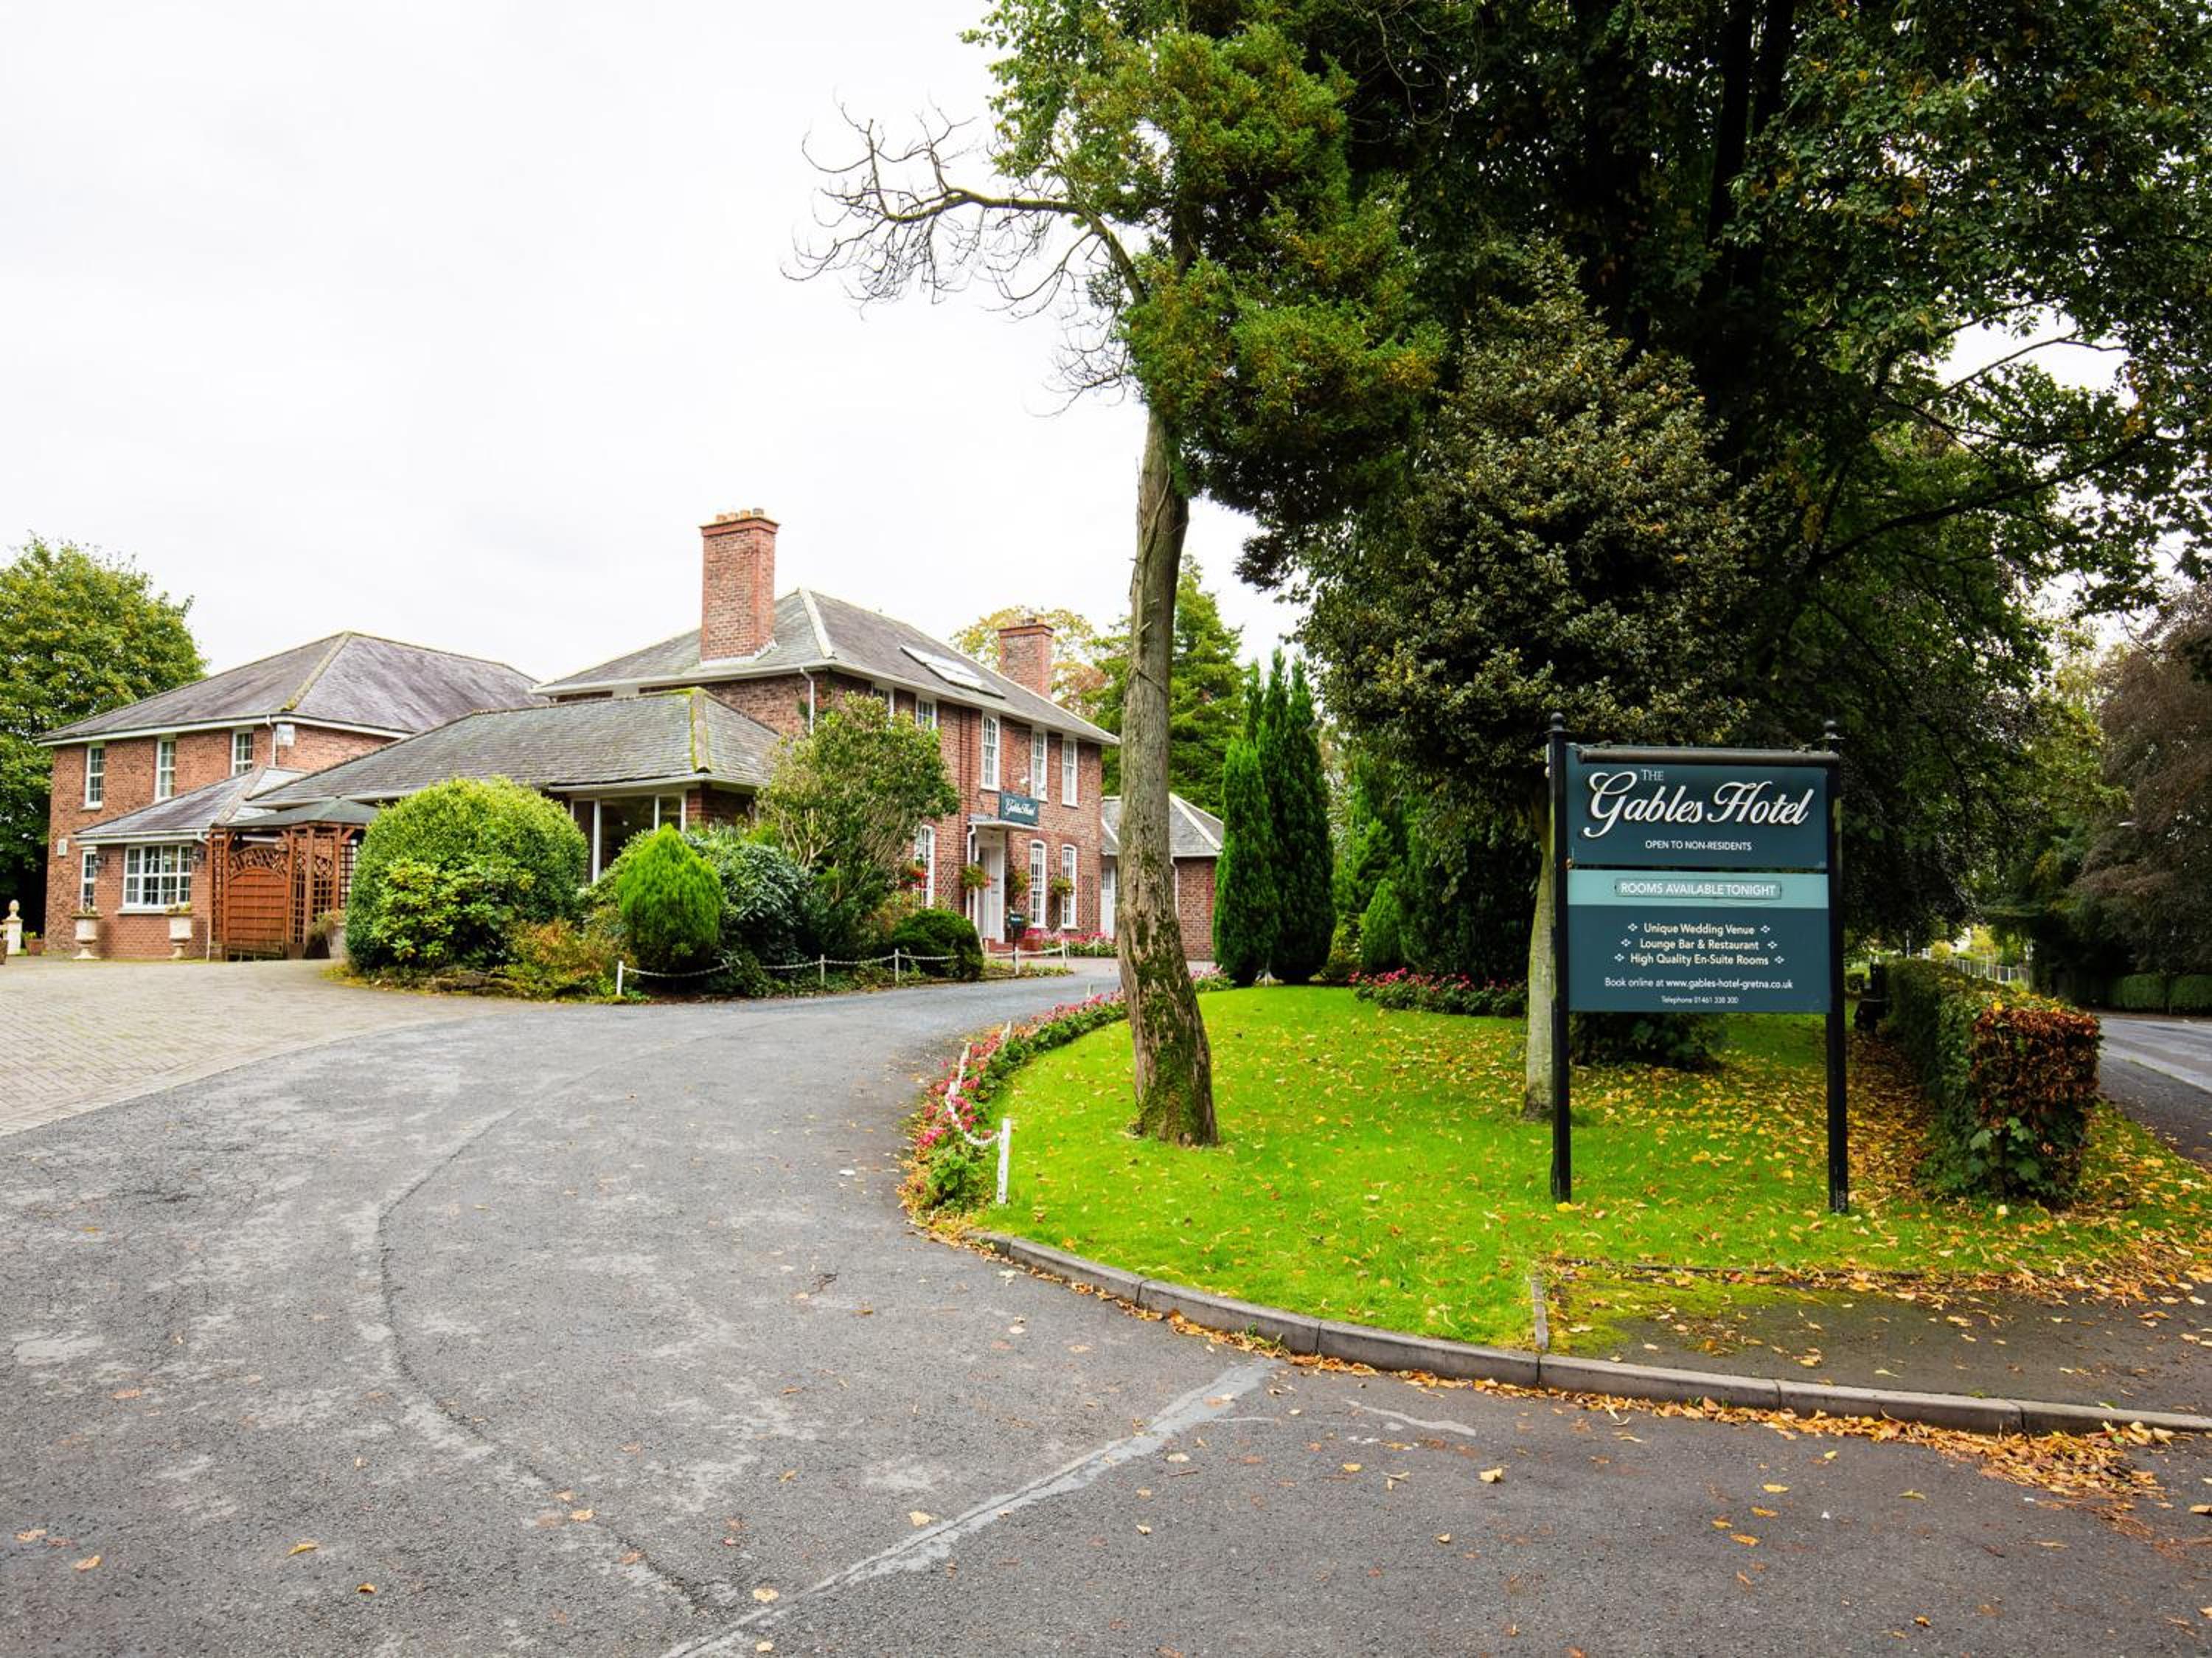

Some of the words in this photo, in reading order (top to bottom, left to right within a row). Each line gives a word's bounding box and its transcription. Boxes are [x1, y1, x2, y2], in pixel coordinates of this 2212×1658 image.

[1641, 769, 1664, 782] THE
[1583, 771, 1703, 839] Gables
[1707, 781, 1815, 825] Hotel
[1645, 840, 1669, 849] OPEN
[1671, 840, 1683, 849] TO
[1685, 841, 1752, 851] NON-RESIDENTS
[1621, 882, 1663, 895] ROOMS
[1666, 884, 1723, 895] AVAILABLE
[1727, 885, 1776, 897] TONIGHT
[1644, 923, 1679, 935] Unique
[1680, 923, 1723, 937] Wedding
[1725, 924, 1755, 934] Venue
[1640, 938, 1676, 951] Lounge
[1678, 939, 1695, 949] Bar
[1697, 940, 1705, 949] &
[1708, 939, 1759, 950] Restaurant
[1630, 952, 1654, 966] High
[1656, 954, 1692, 967] Quality
[1694, 954, 1733, 964] En-Suite
[1736, 955, 1769, 965] Rooms
[1604, 977, 1627, 987] Book
[1627, 977, 1654, 987] online
[1655, 979, 1664, 987] at
[1666, 978, 1793, 990] www.gables-hotel-gretna.co.uk
